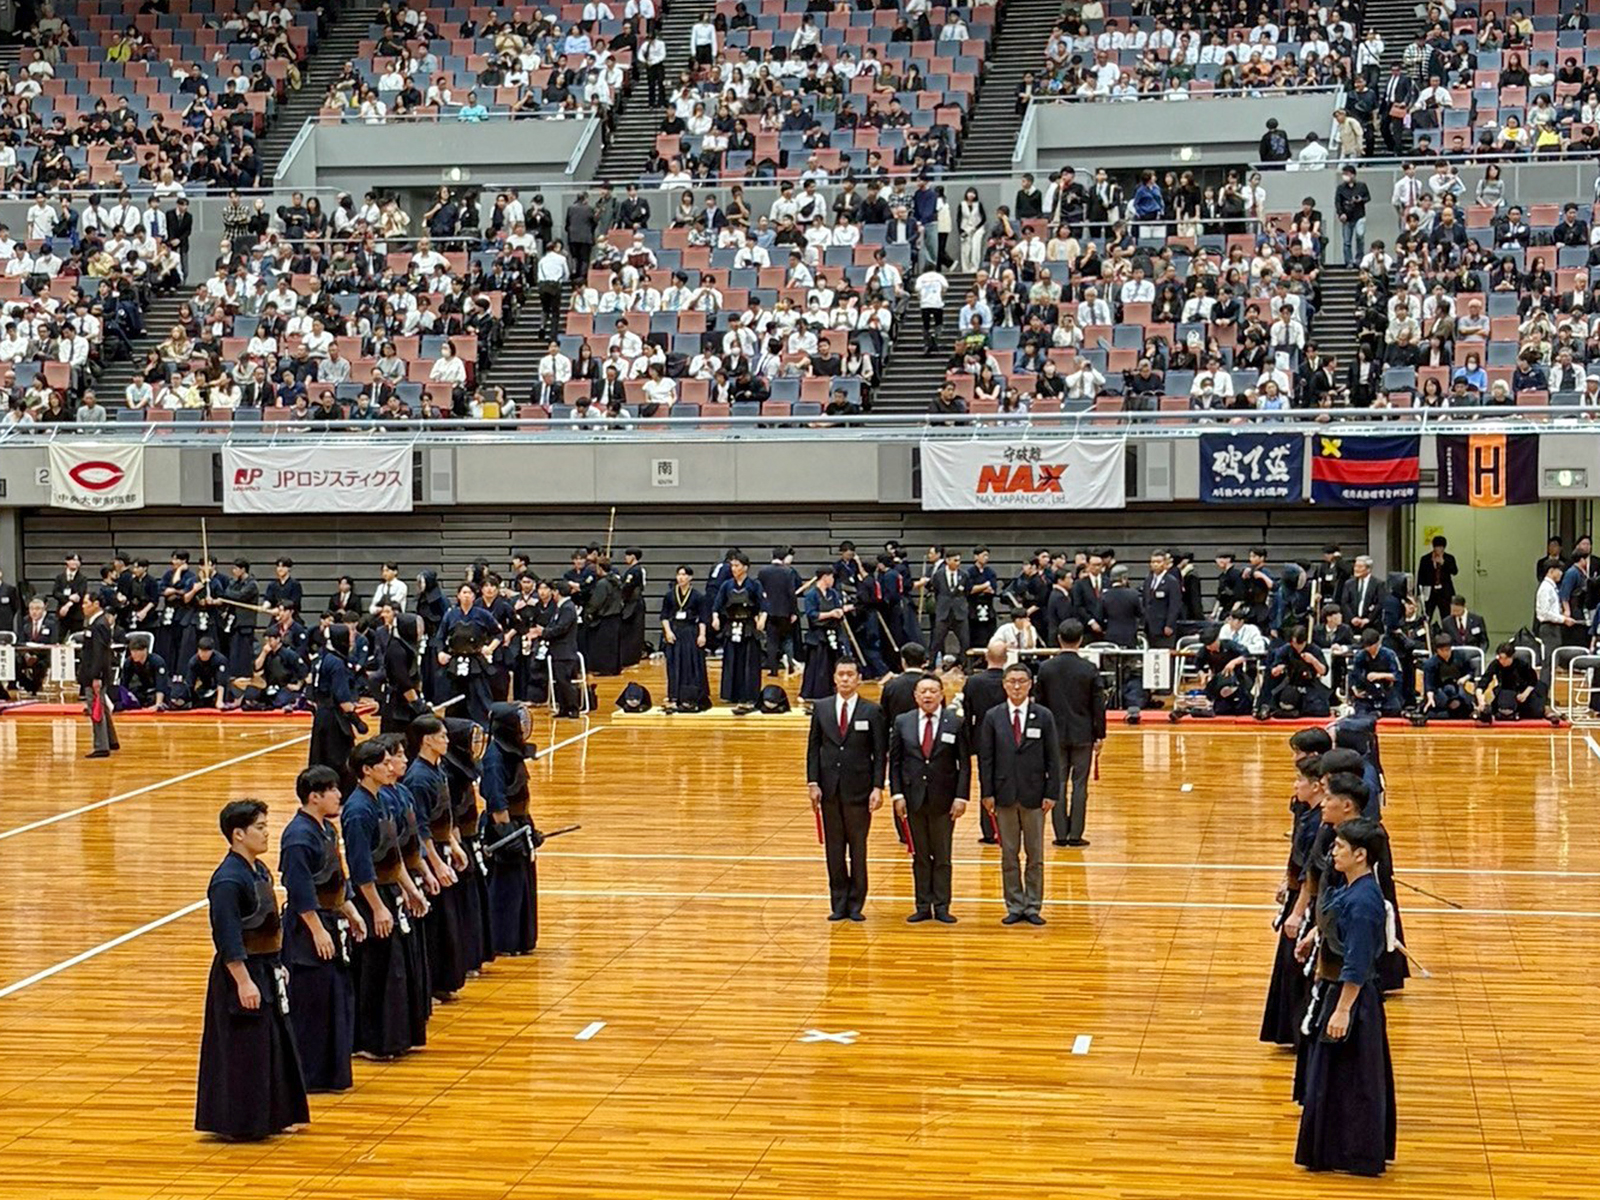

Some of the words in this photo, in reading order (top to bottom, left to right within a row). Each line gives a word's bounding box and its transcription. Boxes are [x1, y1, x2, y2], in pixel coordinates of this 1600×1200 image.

[272, 470, 403, 488] JPロジスティクス
[657, 461, 672, 476] 南
[976, 464, 1069, 493] NAX
[1474, 445, 1501, 496] H
